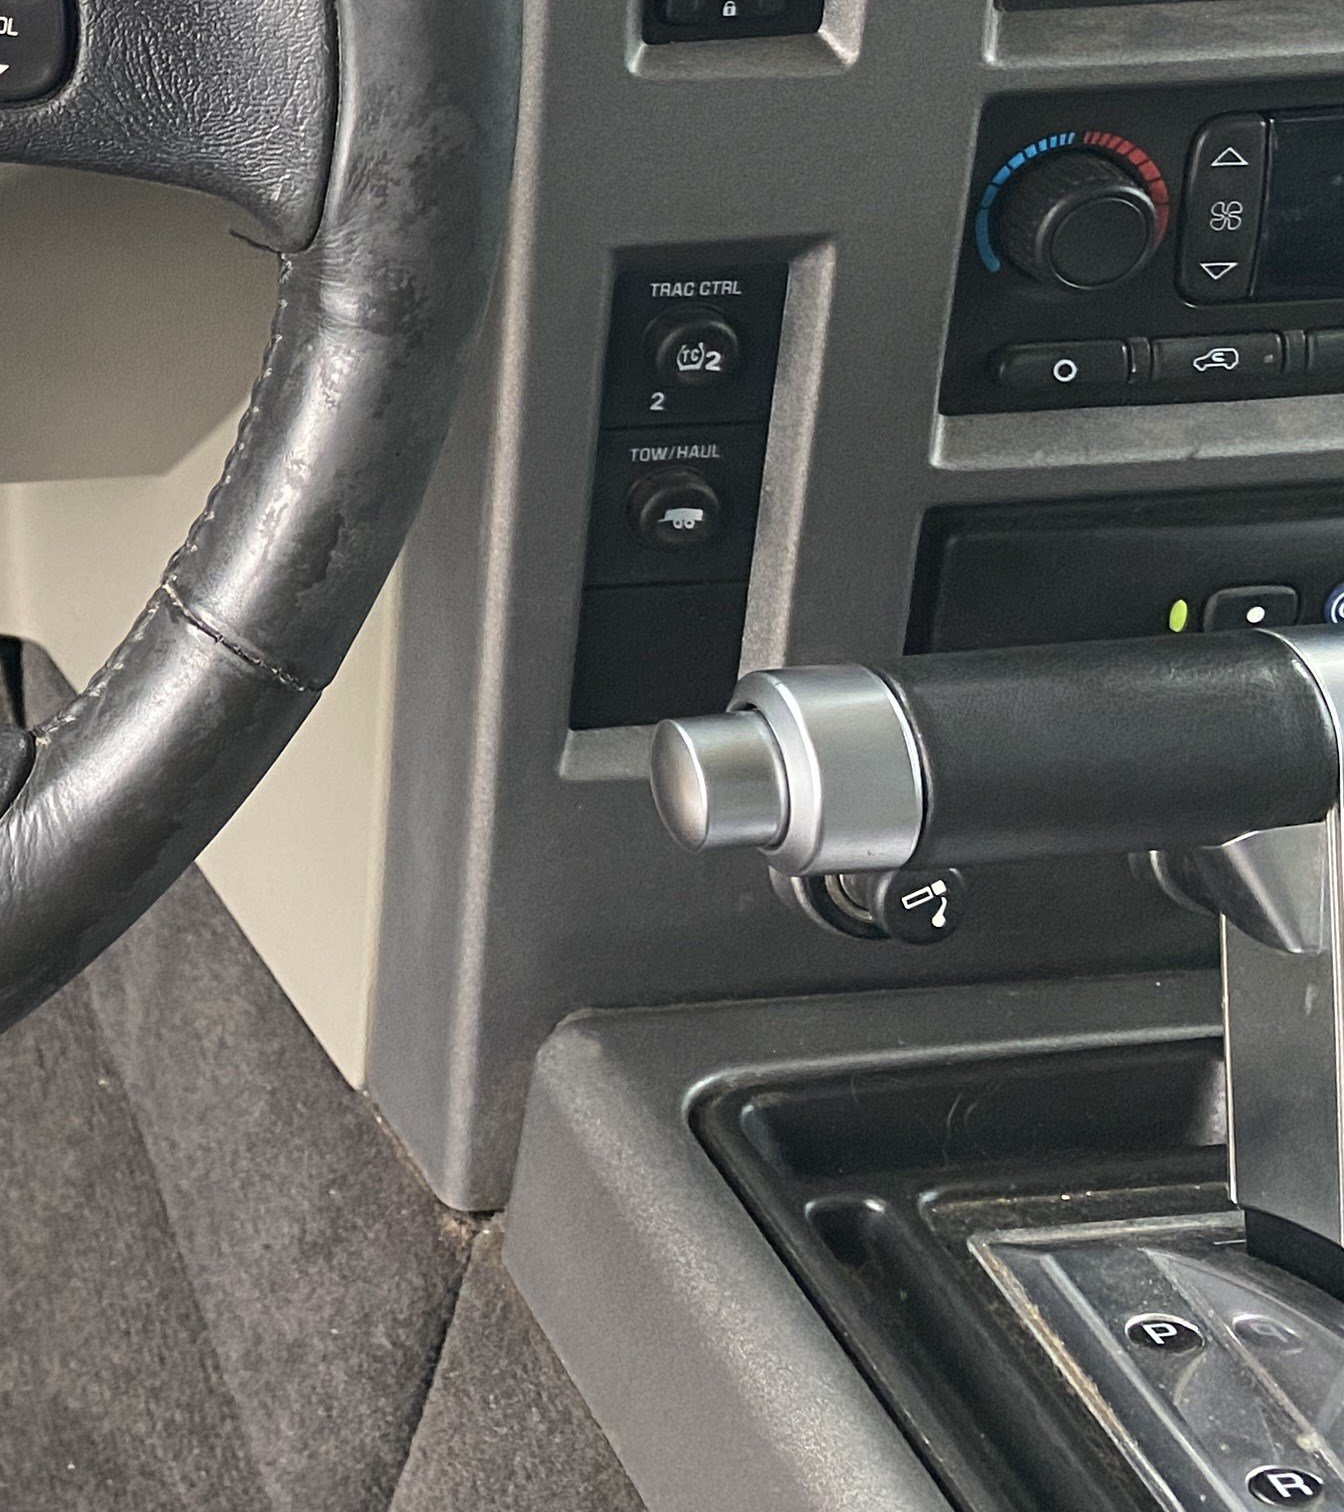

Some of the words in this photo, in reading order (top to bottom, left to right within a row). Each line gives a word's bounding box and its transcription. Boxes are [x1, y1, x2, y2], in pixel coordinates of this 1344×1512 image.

[649, 283, 695, 297] TRAC
[700, 281, 742, 296] CTRL
[649, 392, 665, 410] 2
[630, 444, 720, 462] TOW/HAUL
[1142, 1323, 1179, 1345] P
[1267, 1473, 1313, 1498] R
